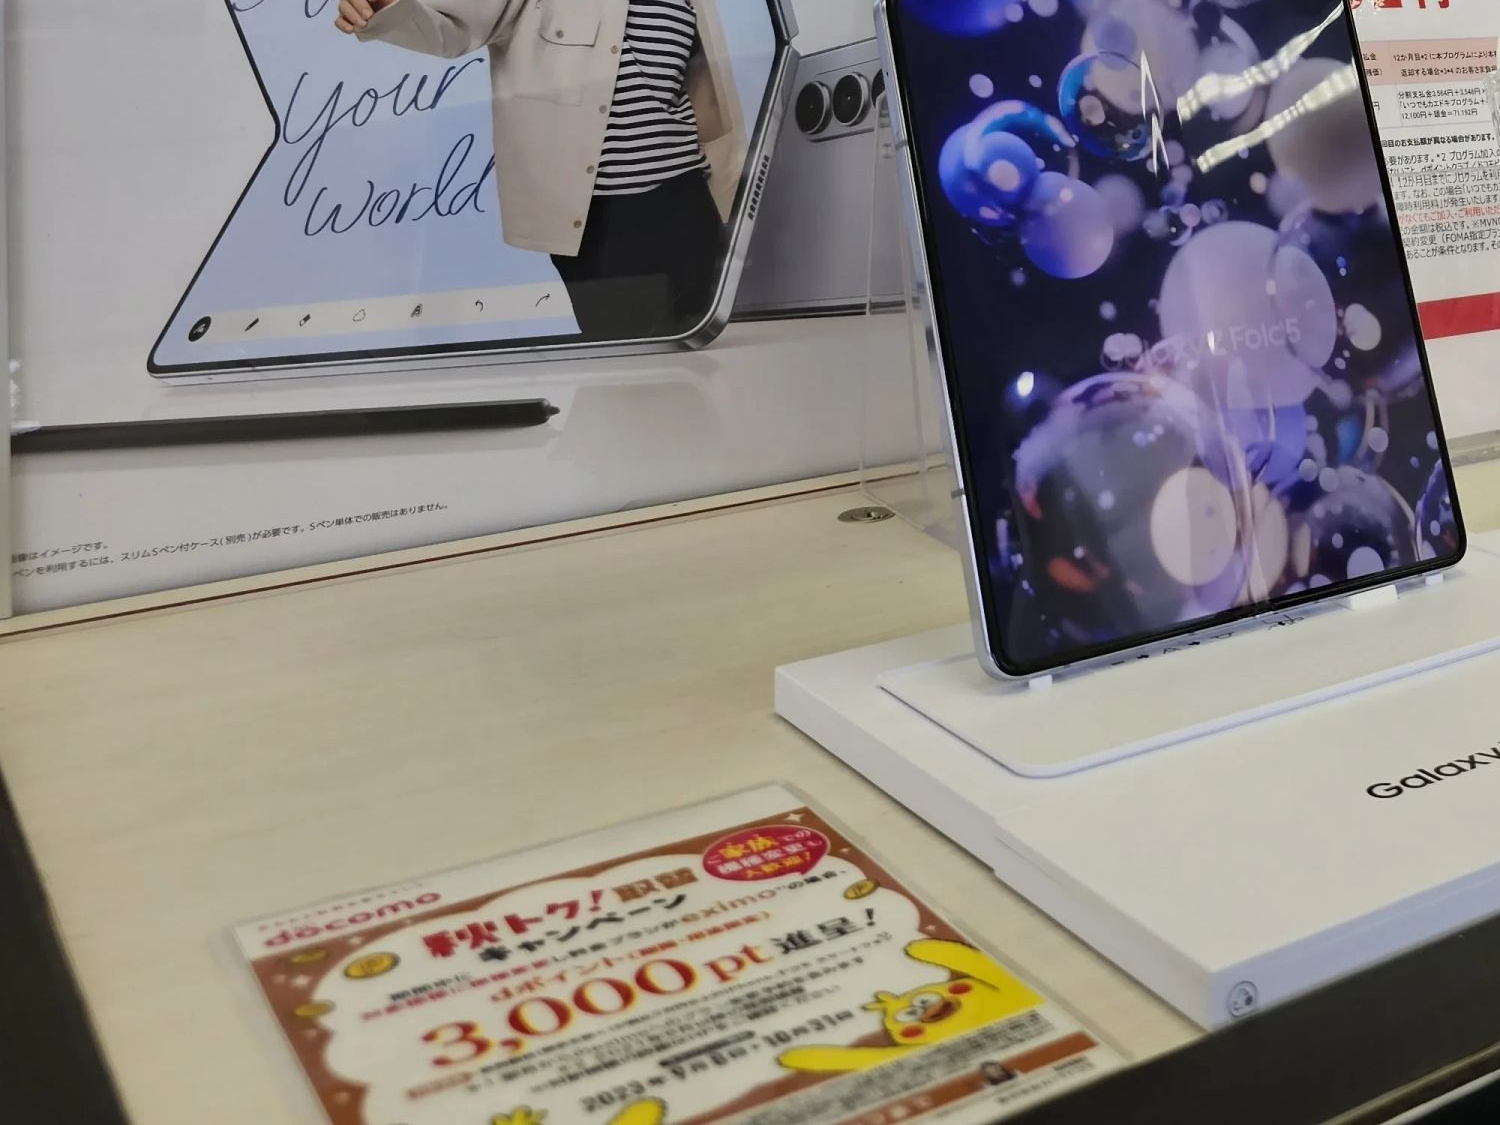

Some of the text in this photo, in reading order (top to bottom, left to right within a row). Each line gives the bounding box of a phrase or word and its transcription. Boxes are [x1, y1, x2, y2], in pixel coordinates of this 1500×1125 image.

[282, 58, 485, 207] your
[305, 134, 495, 236] world
[11, 541, 108, 564] 像はイメージです。
[265, 891, 441, 948] docomo
[479, 894, 686, 961] キャンペーン
